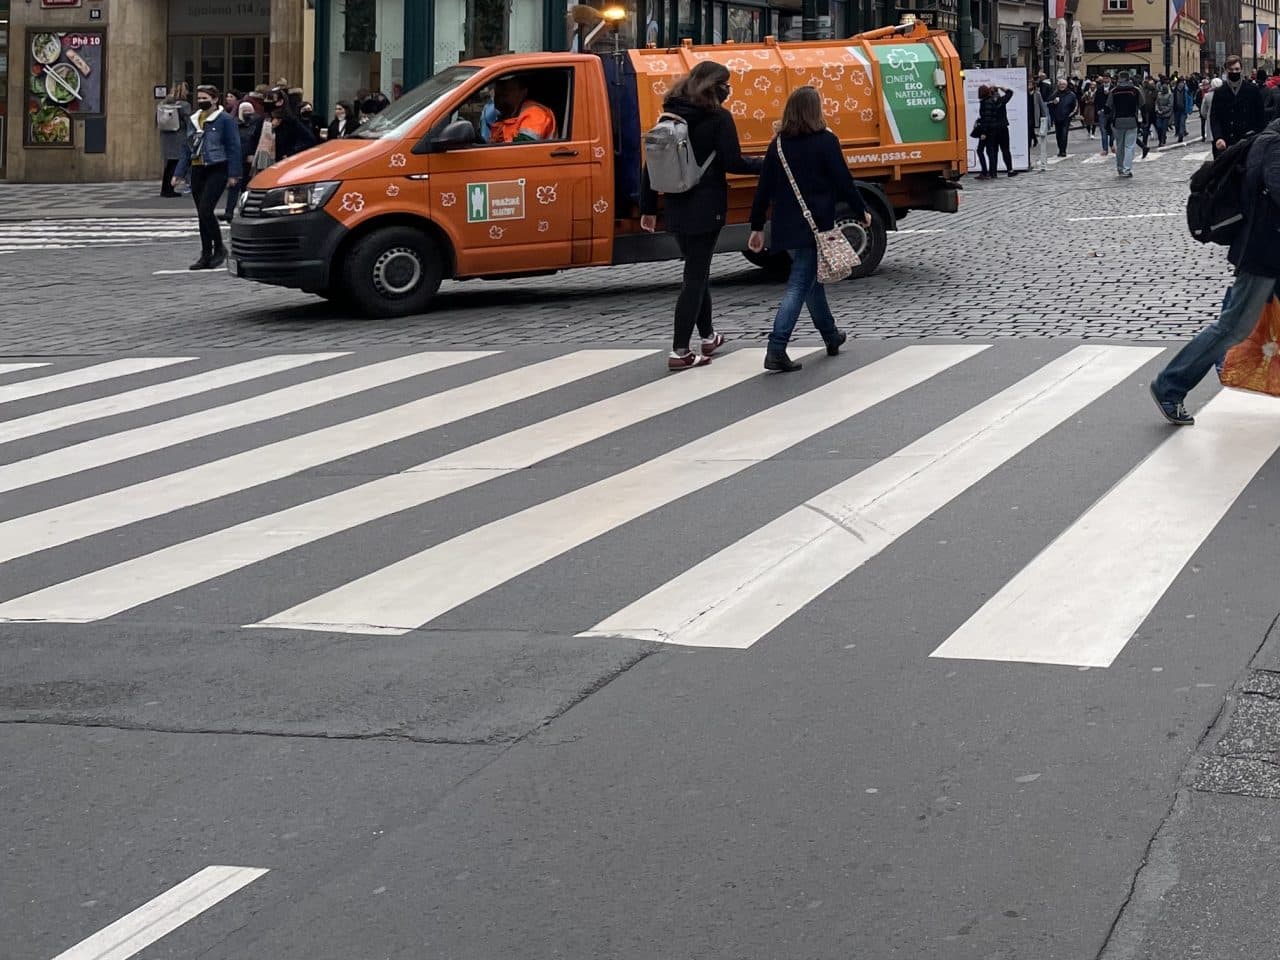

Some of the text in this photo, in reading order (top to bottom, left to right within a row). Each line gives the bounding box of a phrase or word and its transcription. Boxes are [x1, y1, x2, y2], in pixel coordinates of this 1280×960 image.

[90, 37, 100, 45] 10
[904, 82, 923, 90] EKO
[906, 97, 936, 106] SERVIS
[847, 150, 922, 163] www.psas.cz
